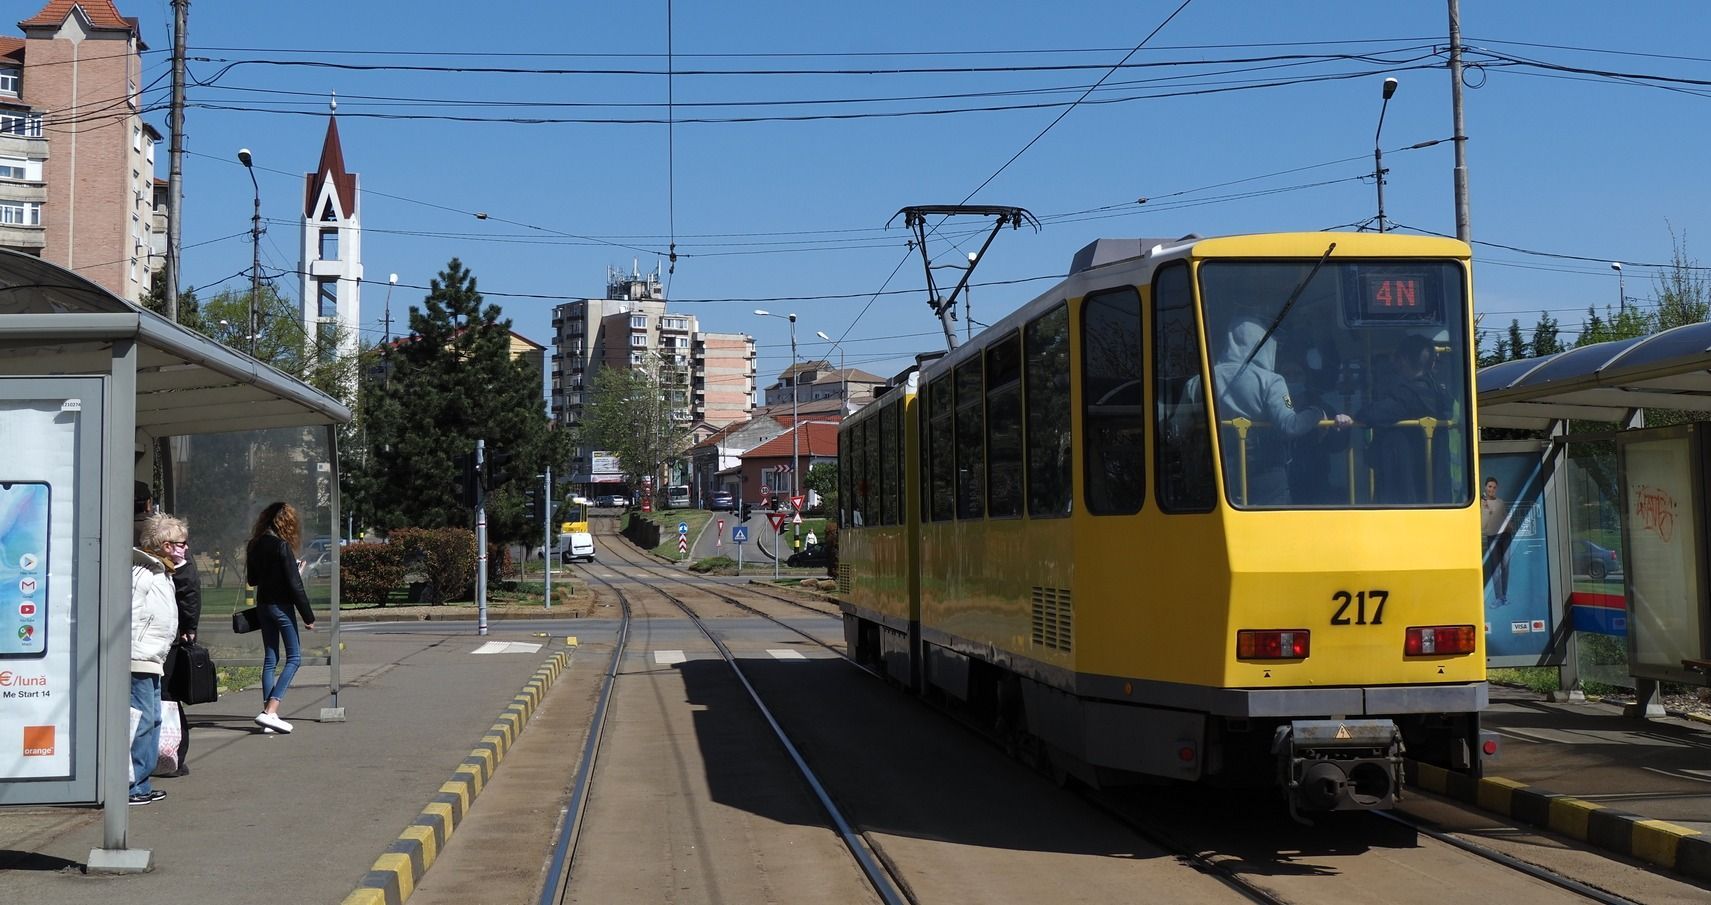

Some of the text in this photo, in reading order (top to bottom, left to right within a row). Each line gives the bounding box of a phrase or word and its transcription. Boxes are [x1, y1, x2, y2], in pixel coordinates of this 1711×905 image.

[1376, 280, 1415, 306] 4N
[1330, 590, 1389, 625] 217
[3, 691, 17, 699] Me
[18, 690, 39, 698] Start
[24, 748, 52, 756] orange
